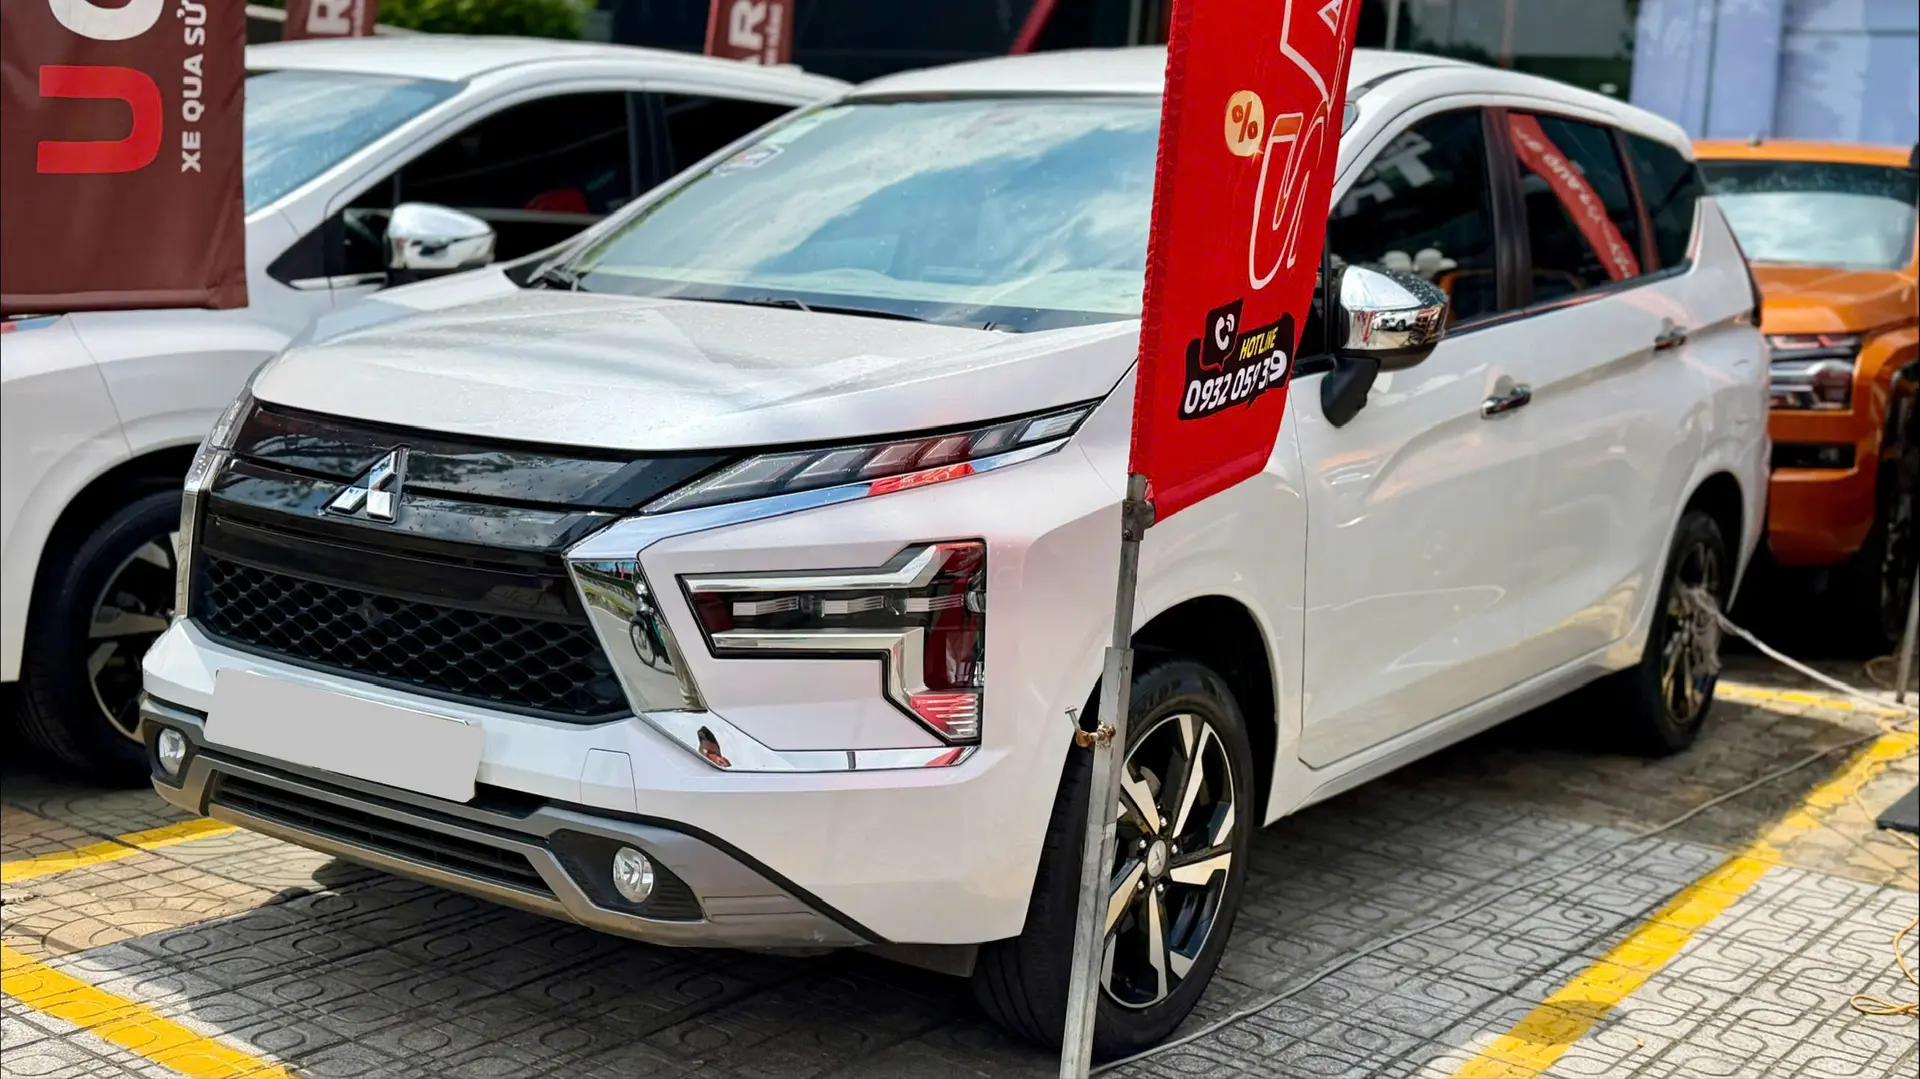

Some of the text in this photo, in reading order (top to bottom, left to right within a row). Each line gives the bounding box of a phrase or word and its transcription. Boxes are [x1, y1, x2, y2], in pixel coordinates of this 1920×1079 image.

[182, 54, 205, 122] QUA
[181, 131, 201, 173] XE
[1239, 326, 1280, 361] HOTLINE
[1184, 372, 1233, 415] 0932
[1230, 362, 1263, 401] 059
